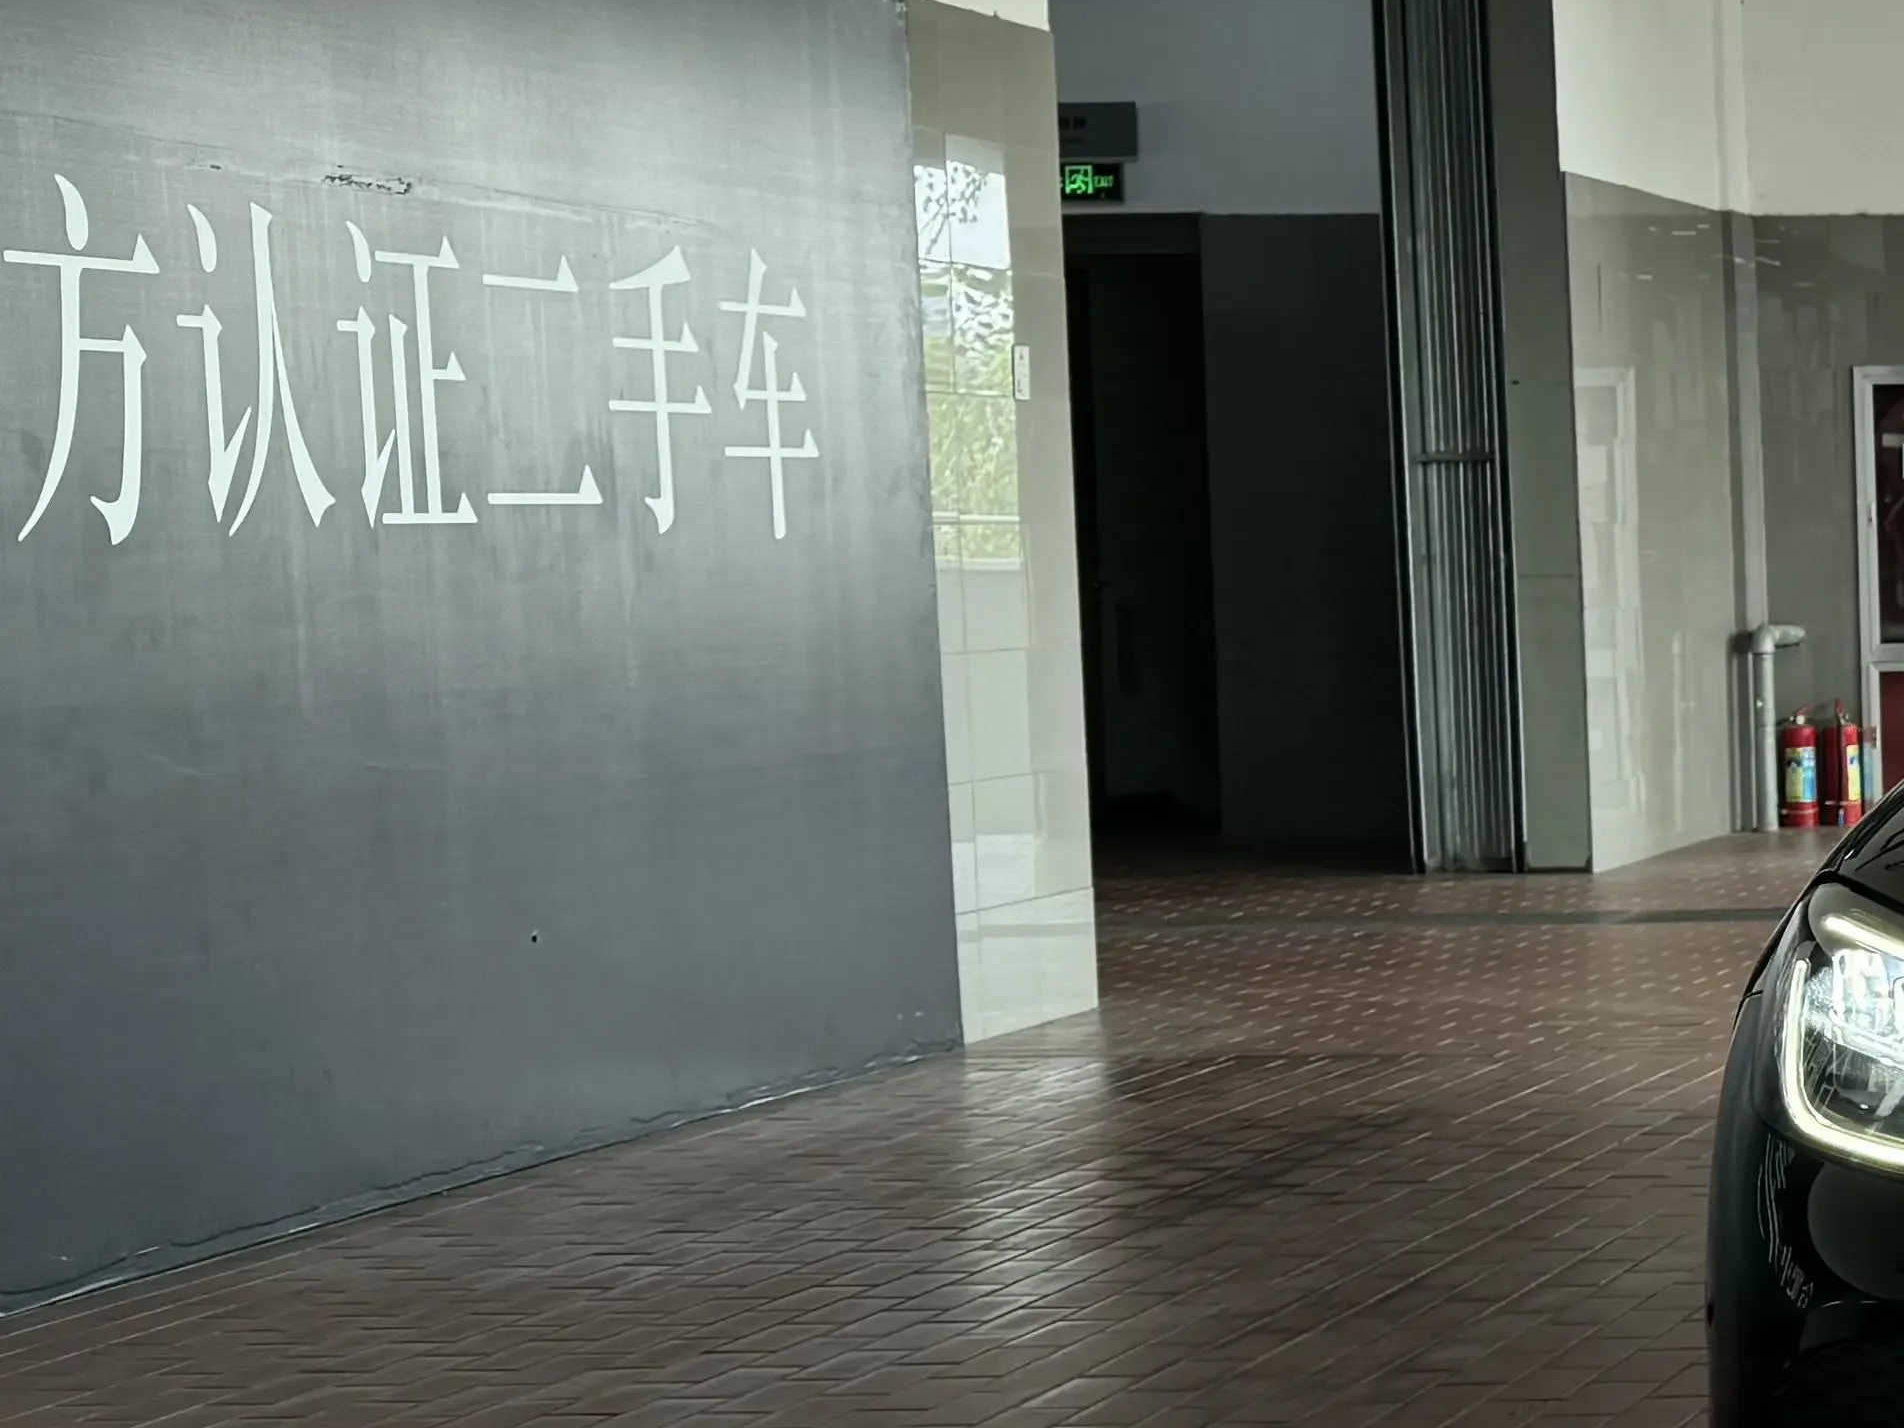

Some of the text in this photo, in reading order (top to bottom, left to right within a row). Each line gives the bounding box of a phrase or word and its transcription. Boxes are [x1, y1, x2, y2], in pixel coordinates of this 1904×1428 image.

[2, 173, 820, 545] 方认证二手车
